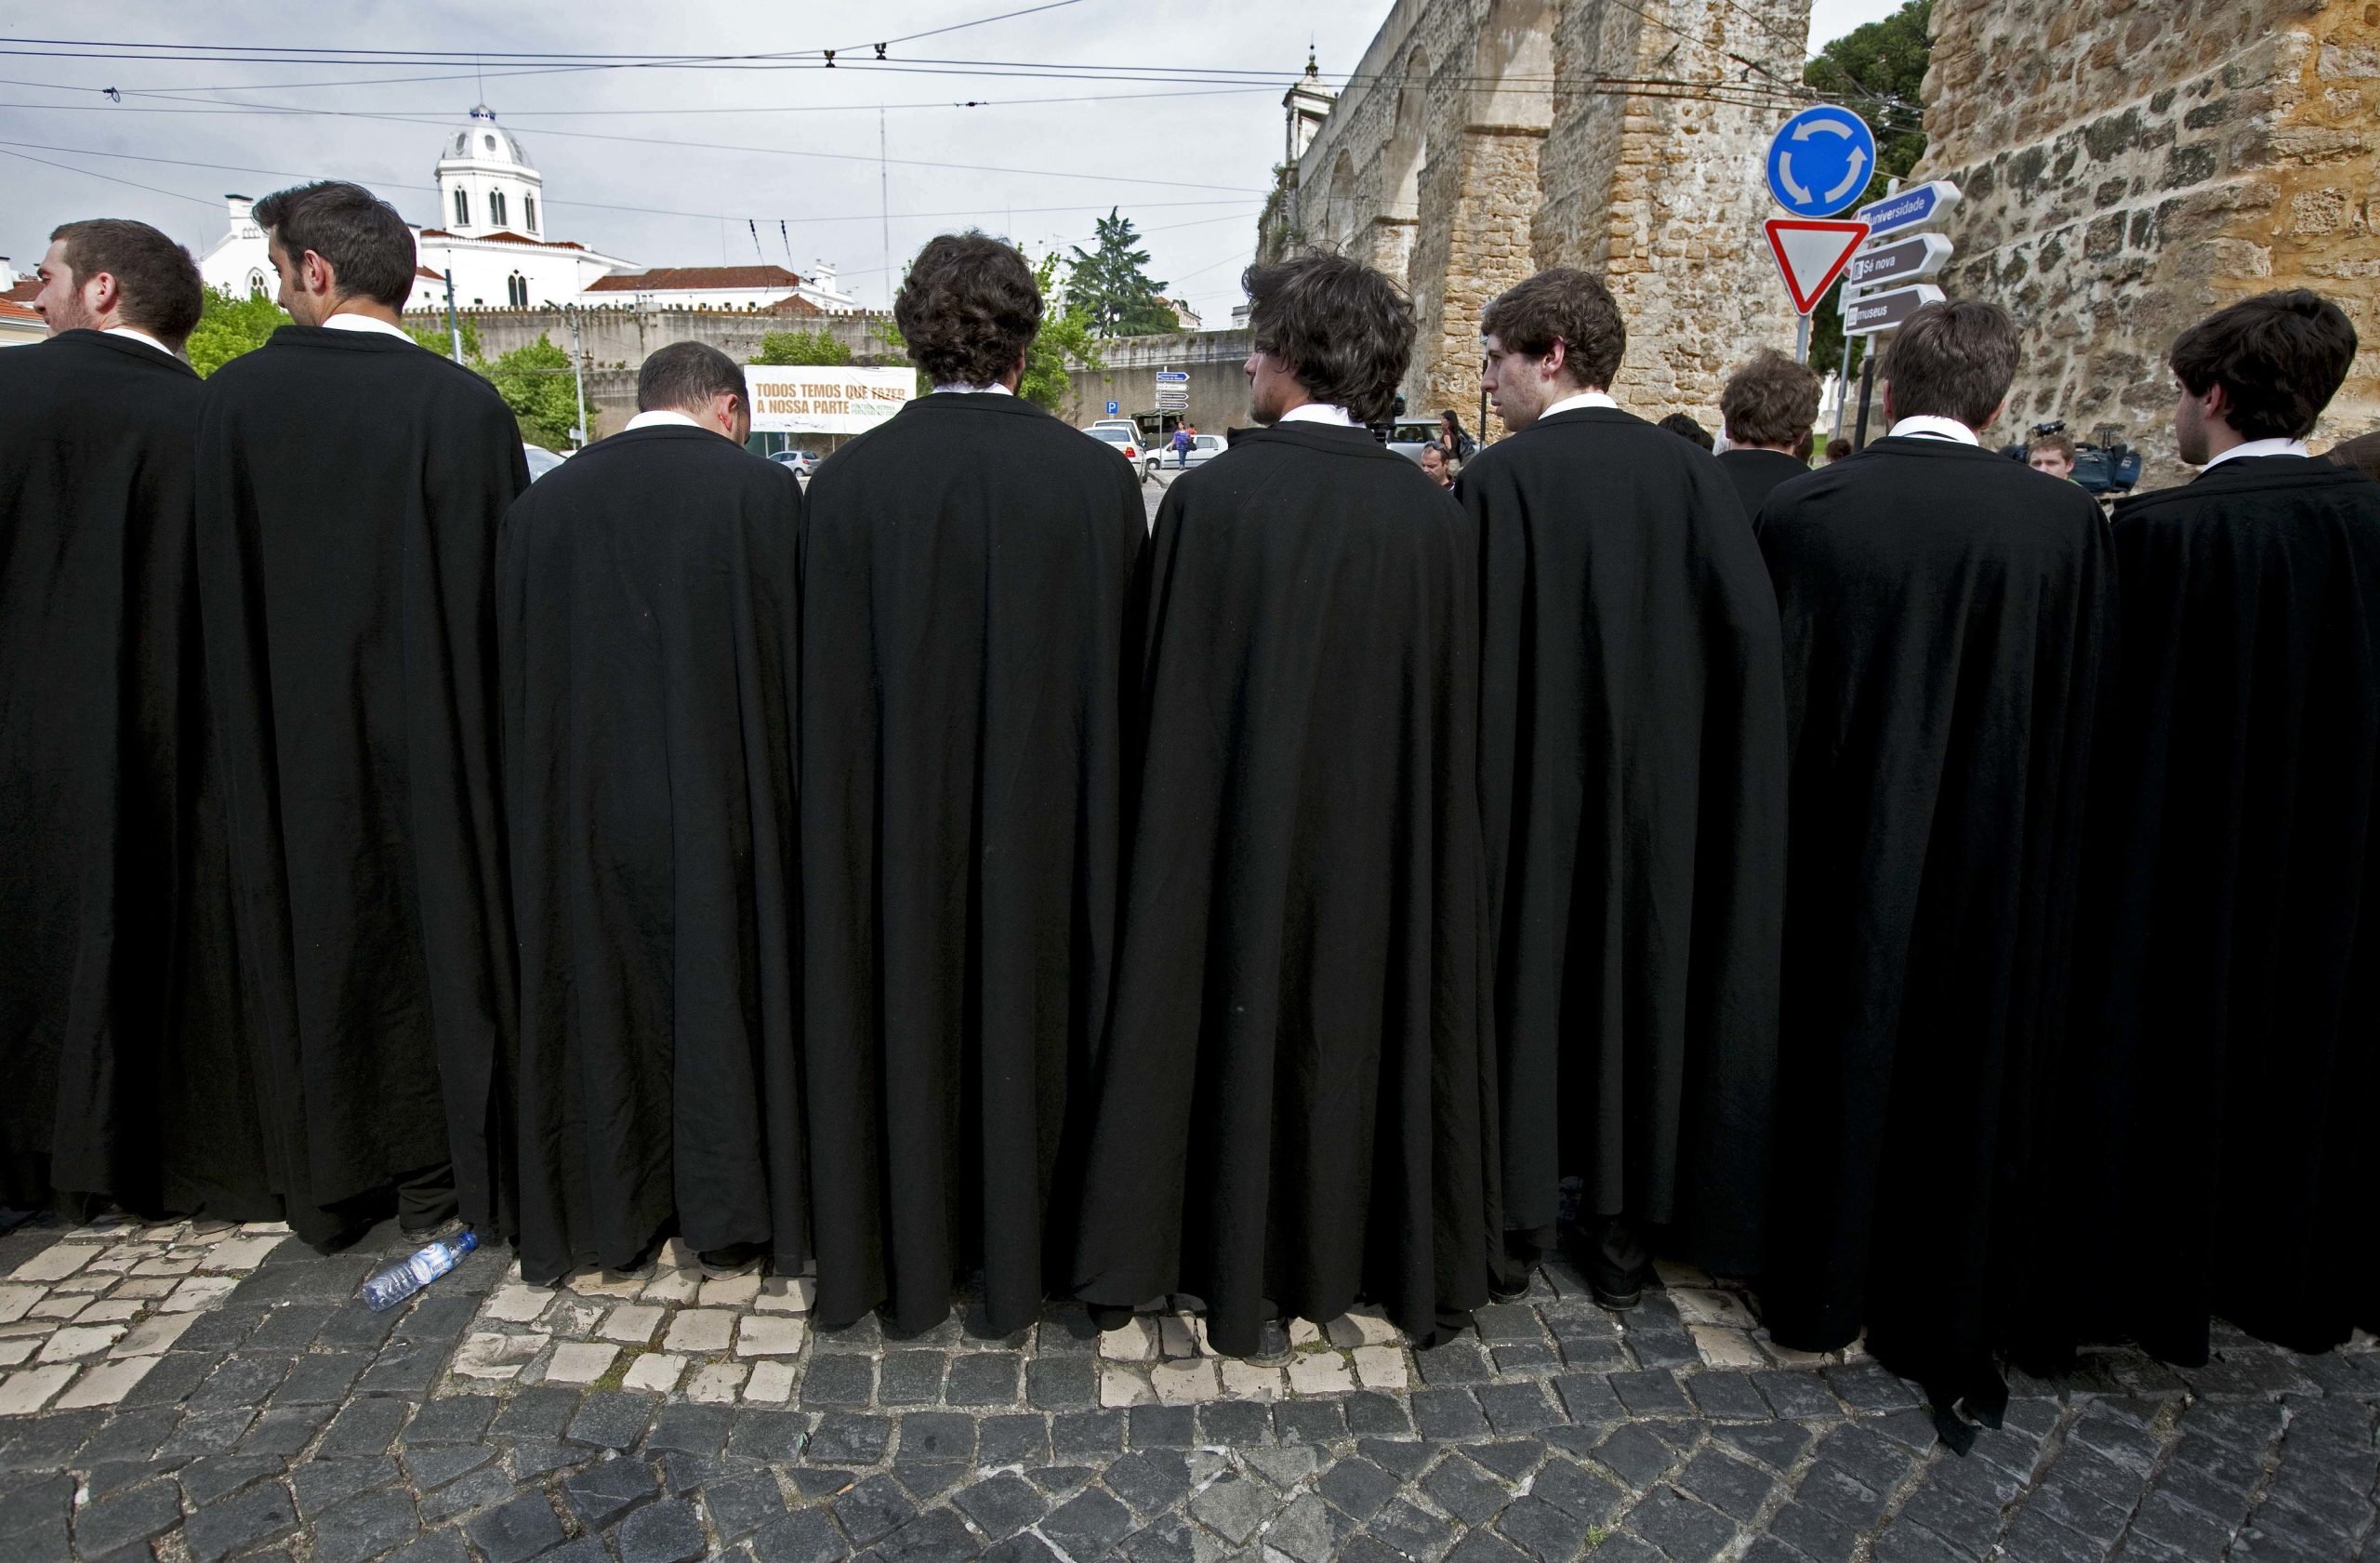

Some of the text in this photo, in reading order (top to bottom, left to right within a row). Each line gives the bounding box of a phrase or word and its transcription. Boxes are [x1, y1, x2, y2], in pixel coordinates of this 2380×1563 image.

[1870, 196, 1924, 224] universidade
[1863, 256, 1896, 274] Sé nova
[1858, 305, 1887, 320] museus
[756, 383, 796, 398] TODOS
[800, 383, 841, 398] TEMOS
[845, 384, 867, 400] QUE
[757, 400, 765, 414] A
[769, 400, 810, 414] NOSSA
[813, 401, 850, 415] PARTE
[1108, 402, 1117, 413] P
